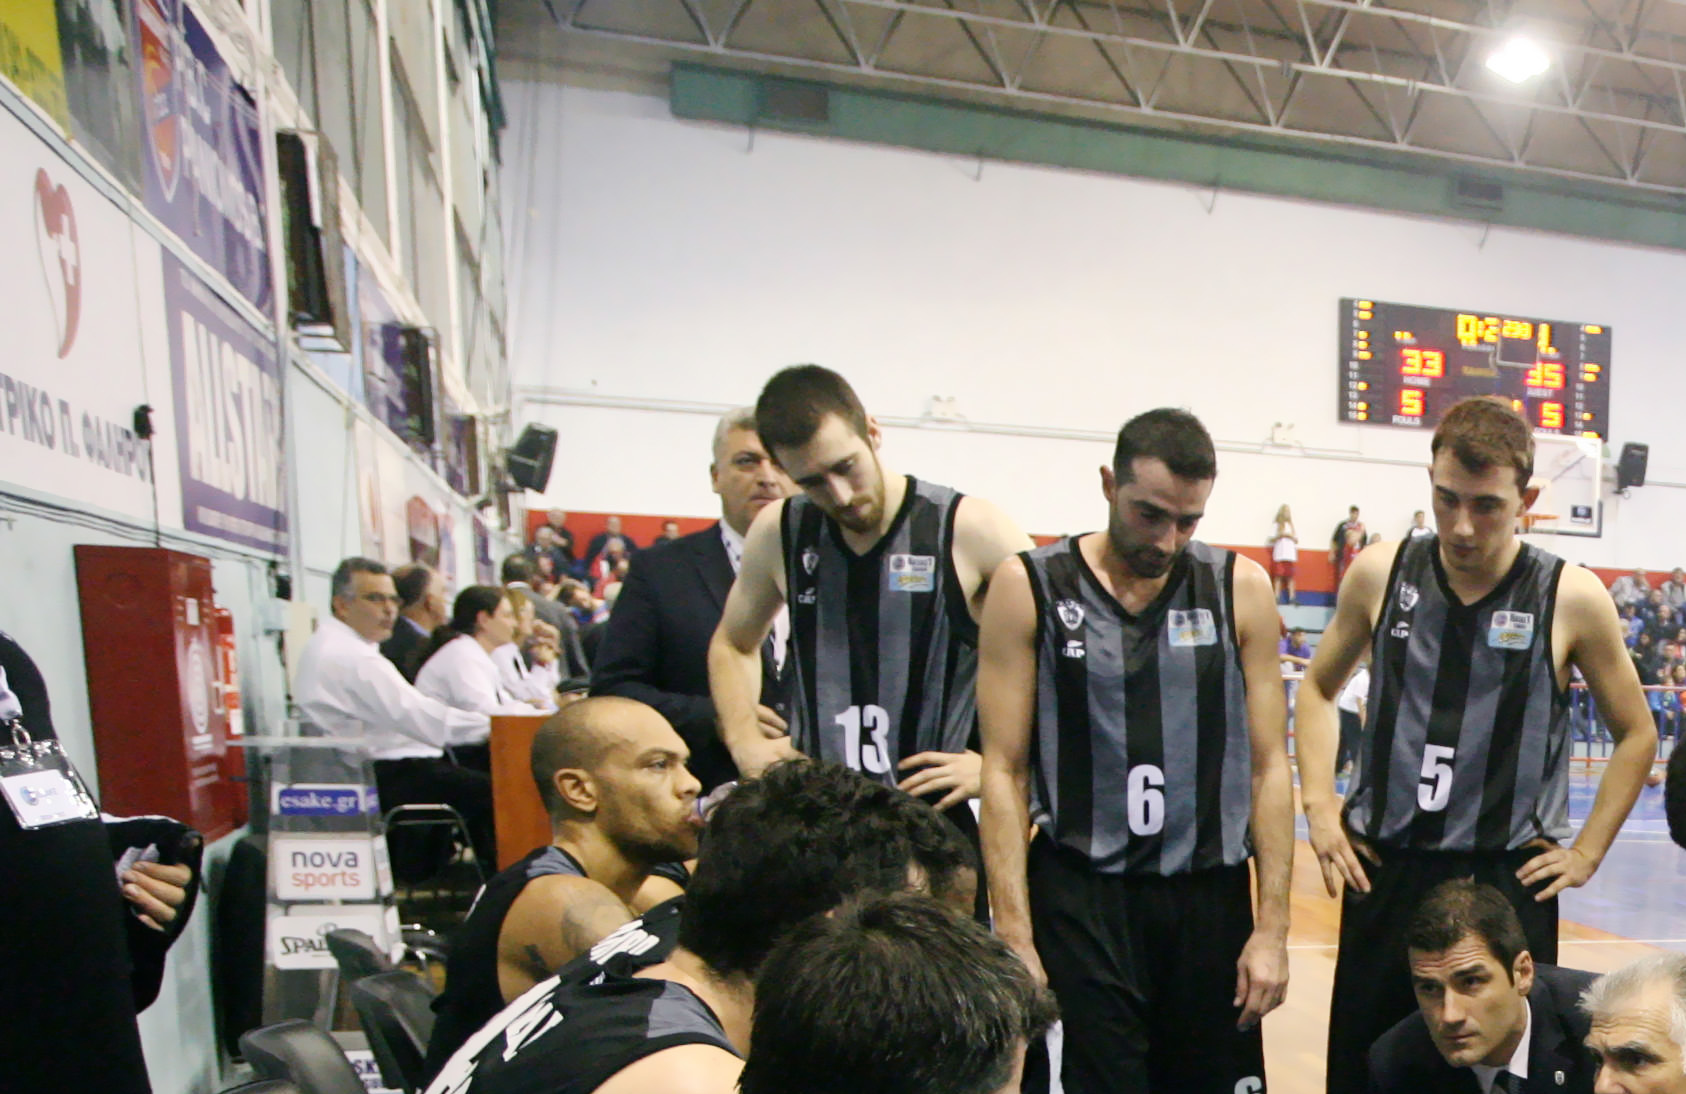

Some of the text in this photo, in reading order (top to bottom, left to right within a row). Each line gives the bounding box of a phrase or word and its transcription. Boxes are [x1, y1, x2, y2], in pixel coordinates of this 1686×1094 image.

[1400, 347, 1445, 378] 33
[1400, 389, 1425, 416] 5
[1540, 401, 1565, 429] 5
[834, 703, 890, 774] 13
[1416, 743, 1455, 812] 5
[280, 791, 357, 813] esake.gr
[1126, 763, 1166, 836] 6
[291, 850, 359, 868] nova
[291, 871, 361, 891] sports
[280, 936, 329, 956] SPAL
